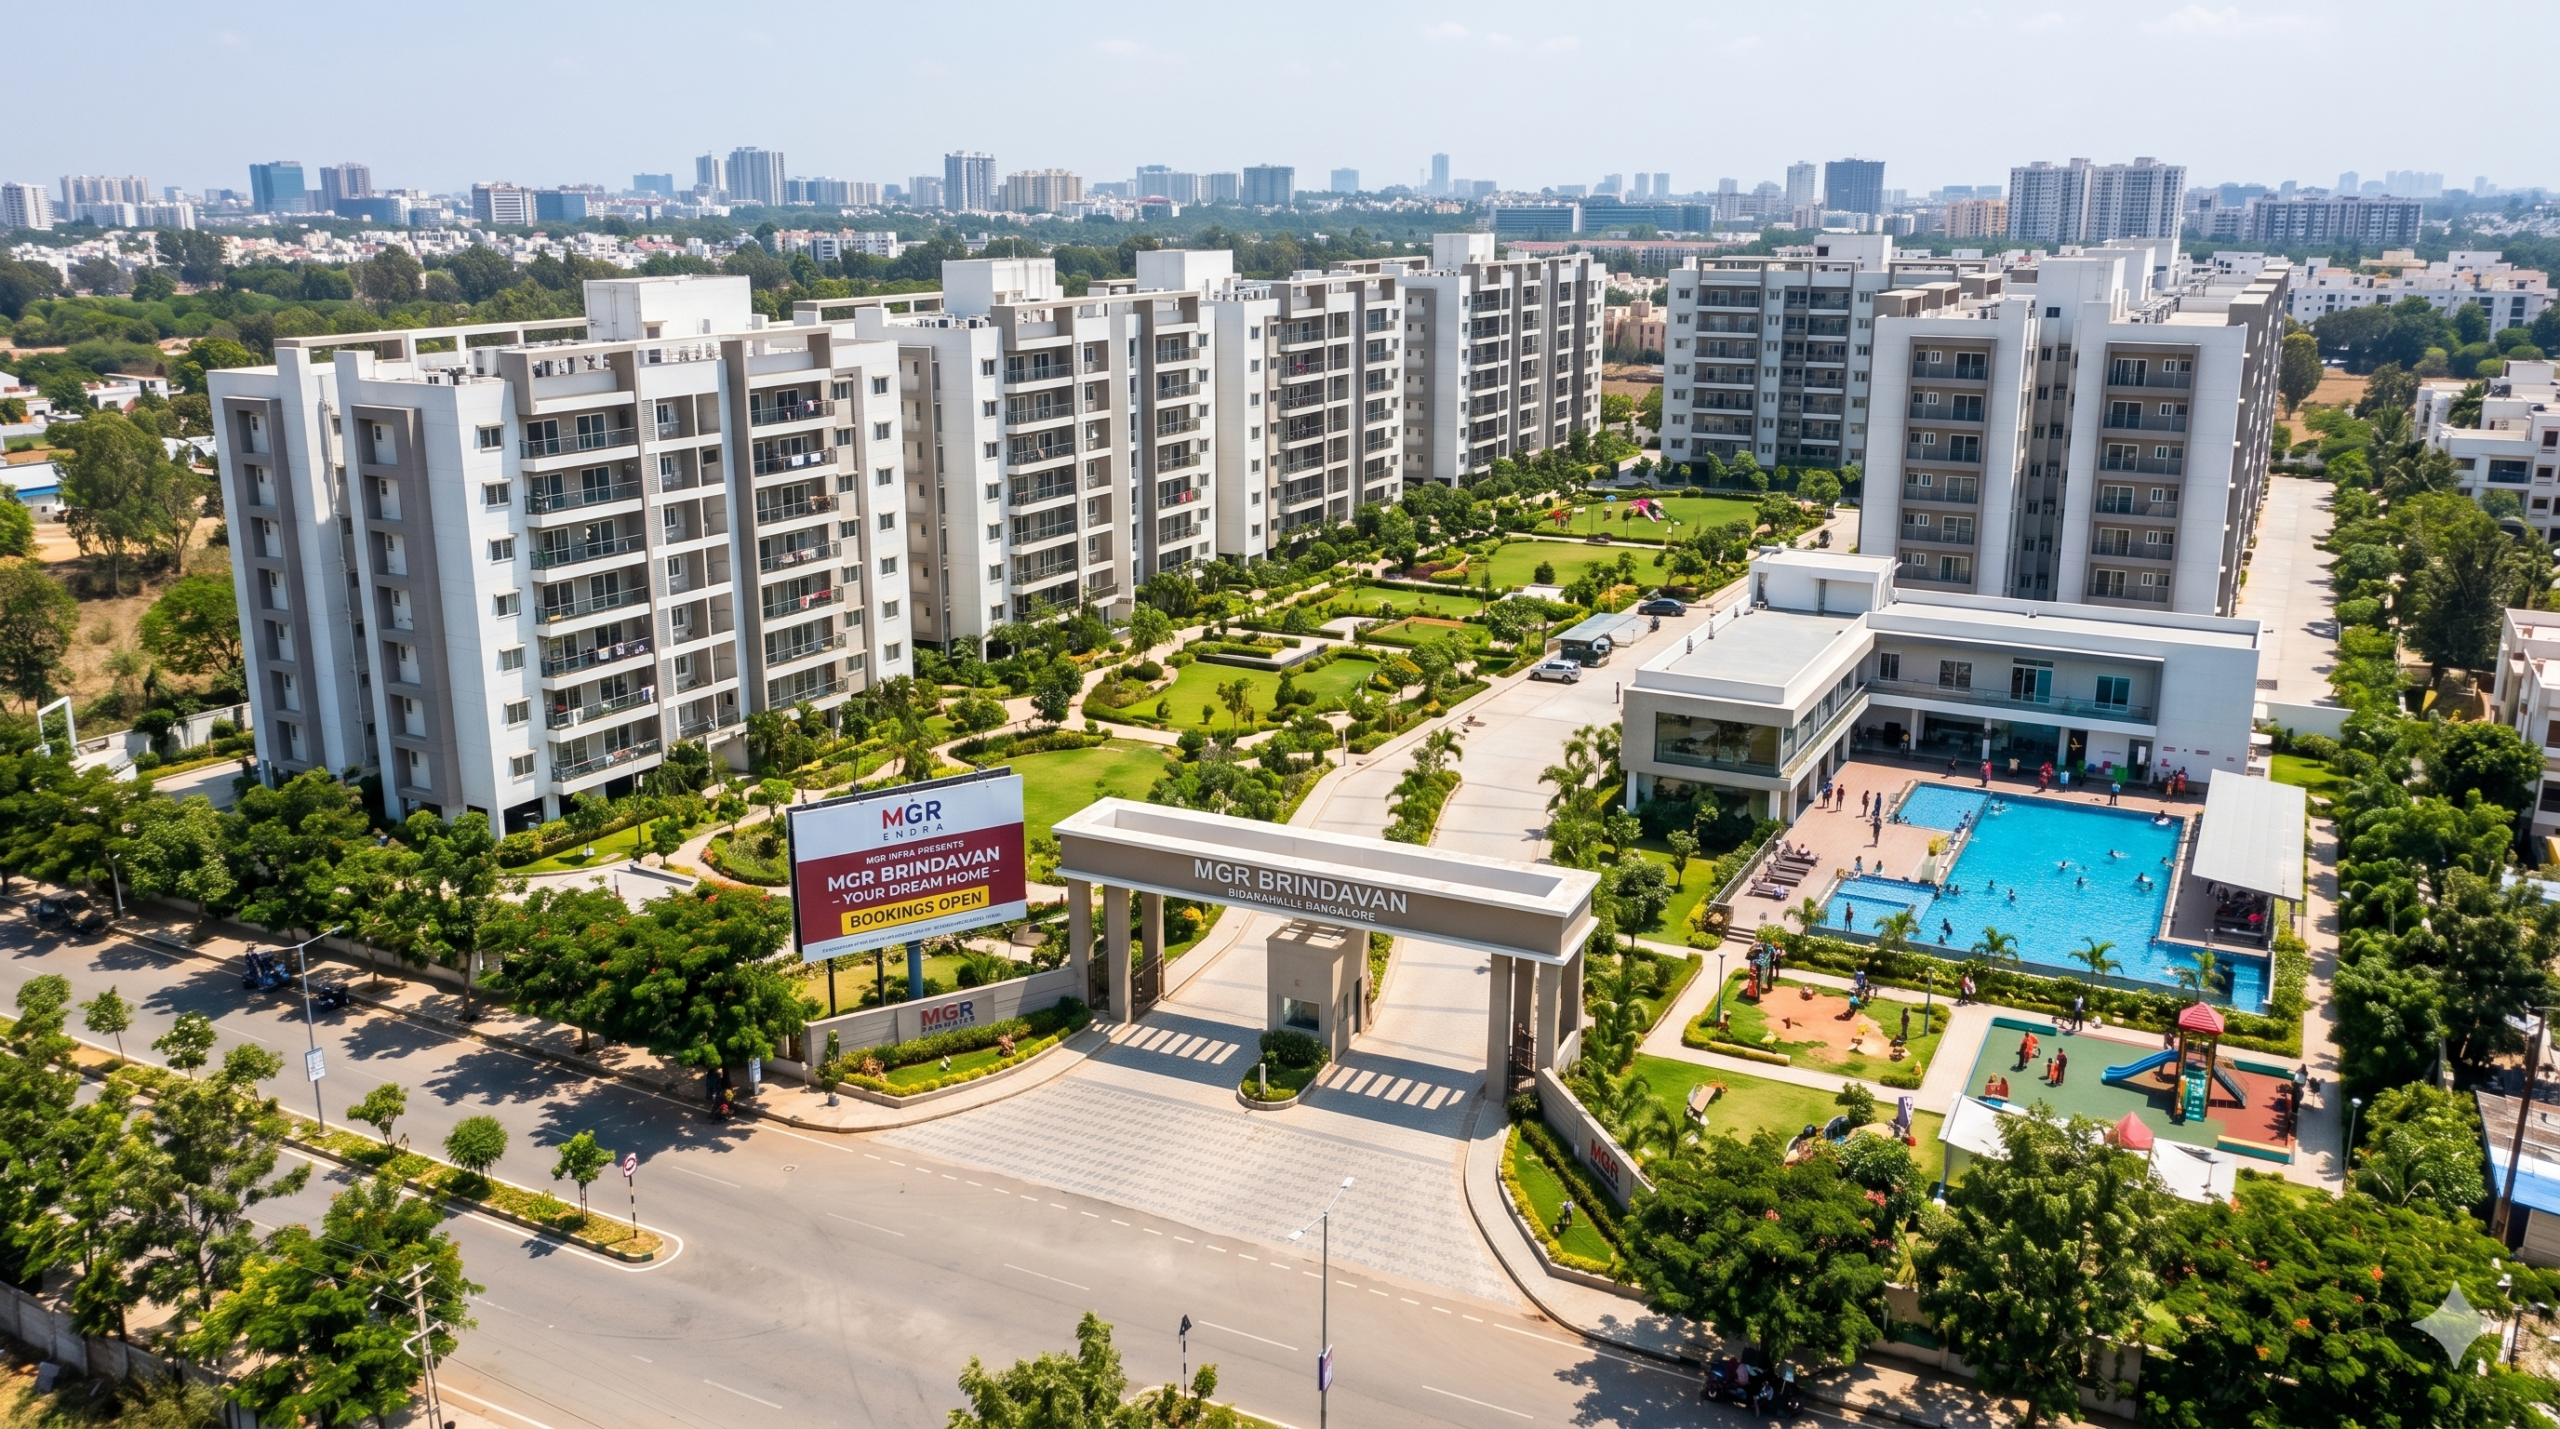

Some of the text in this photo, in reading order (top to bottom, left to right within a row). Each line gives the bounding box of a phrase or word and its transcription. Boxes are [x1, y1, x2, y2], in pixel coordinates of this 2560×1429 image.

[882, 800, 942, 830] MGR
[883, 823, 944, 841] ENDRA
[828, 846, 1000, 892] MGR BRINDAVAN
[866, 840, 964, 865] MGR INFRA PRESENTS
[843, 887, 885, 905] YOUR
[889, 876, 942, 896] DREAM
[947, 867, 989, 885] HOME
[1194, 859, 1407, 914] MGR BRINDAVAN
[850, 891, 982, 929] BOOKINGS OPEN
[1305, 901, 1376, 922] BANGALORE
[921, 1001, 974, 1026] MGR
[1591, 1138, 1618, 1184] MGR
